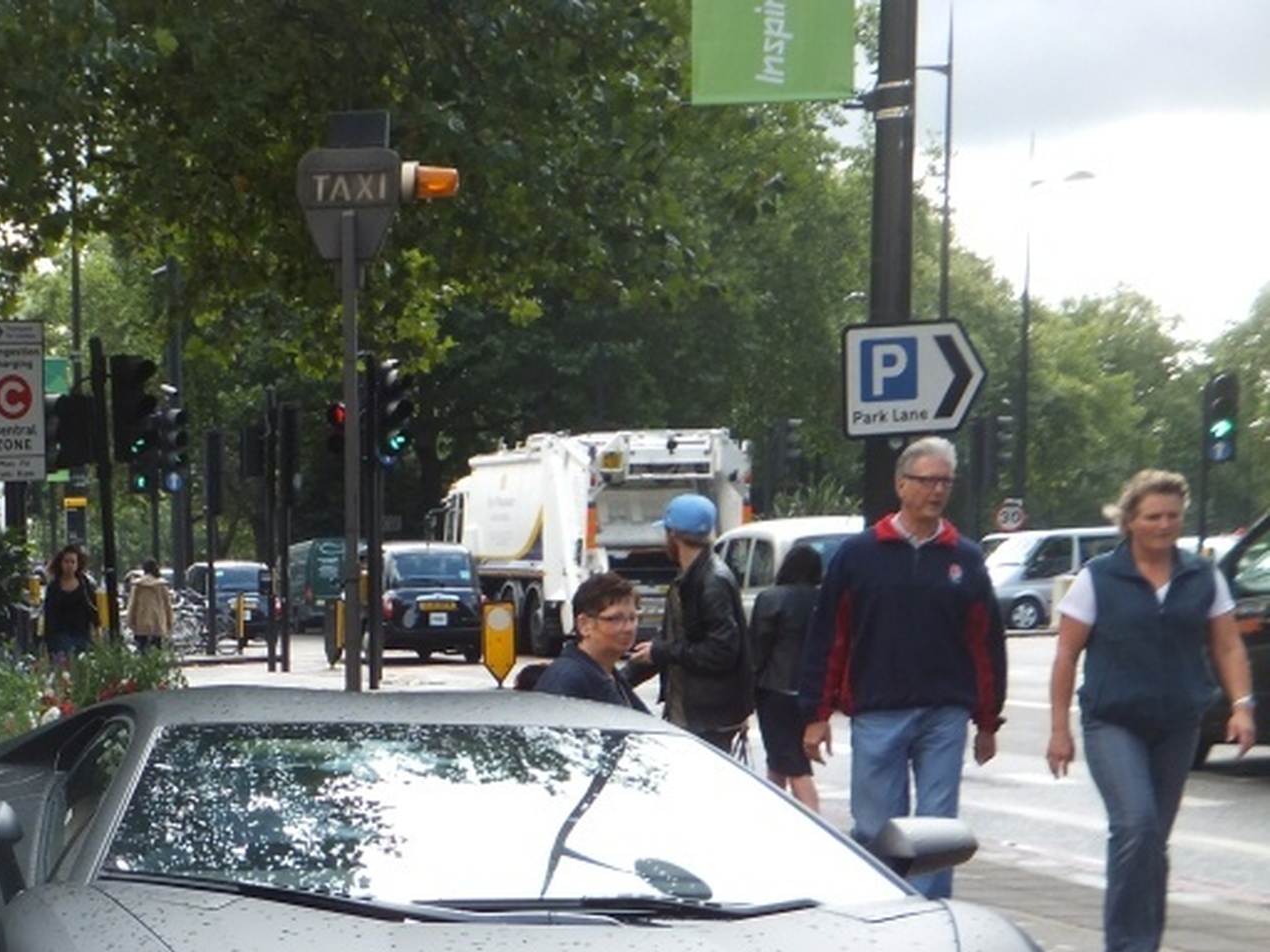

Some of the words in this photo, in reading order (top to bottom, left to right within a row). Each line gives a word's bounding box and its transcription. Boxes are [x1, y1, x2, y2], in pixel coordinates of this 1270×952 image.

[312, 173, 386, 201] TAXI
[871, 343, 908, 397] P
[852, 410, 887, 425] Park
[892, 409, 928, 423] Lane
[1001, 510, 1021, 524] 30
